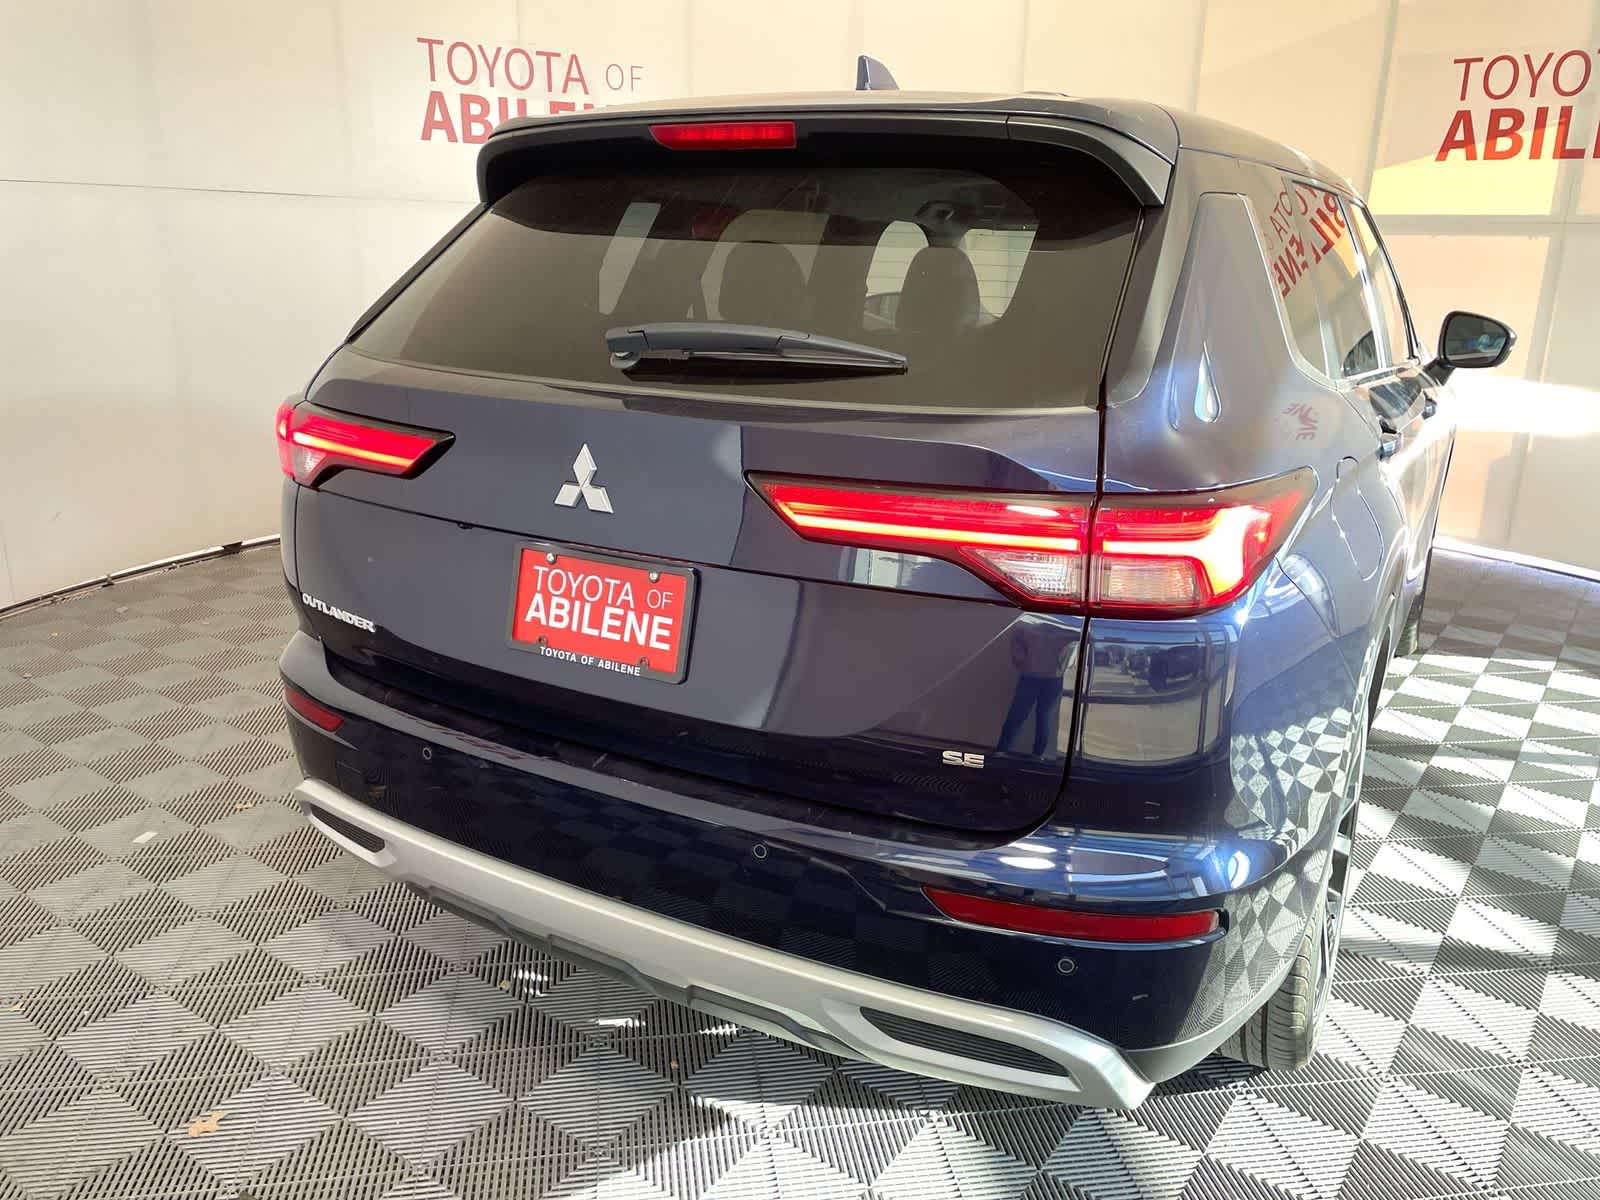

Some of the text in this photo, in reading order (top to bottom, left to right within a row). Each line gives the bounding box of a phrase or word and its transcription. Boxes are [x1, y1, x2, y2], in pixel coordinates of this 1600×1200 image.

[417, 37, 644, 95] TOYOTA OF
[1453, 49, 1600, 101] TOYO
[1435, 105, 1600, 162] ABIL
[533, 565, 673, 609] TOYOTA OF
[302, 592, 376, 633] OUTLANDER
[524, 592, 673, 651] ABILENE
[540, 646, 641, 676] TOYOTA OF ABILENE
[942, 750, 985, 769] SE
